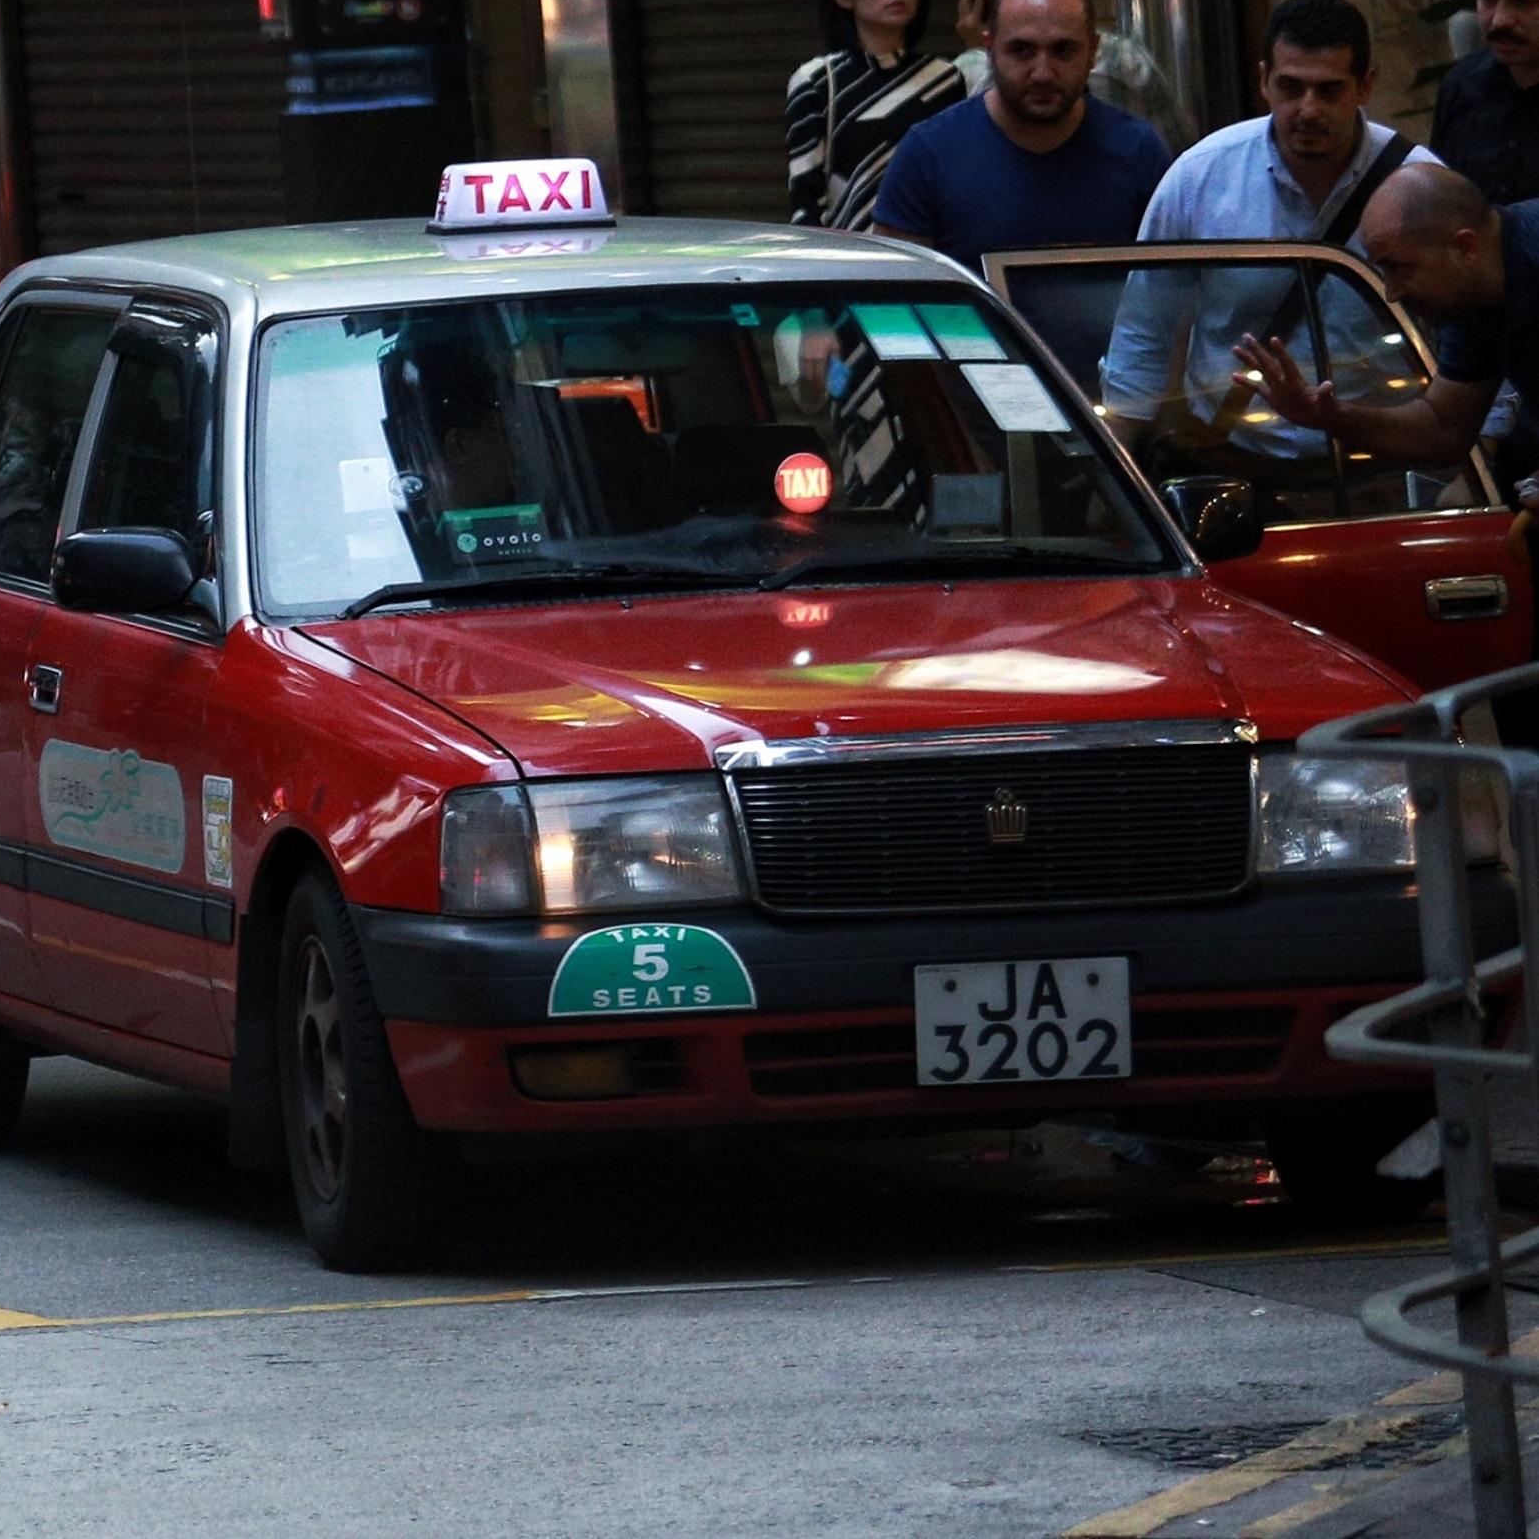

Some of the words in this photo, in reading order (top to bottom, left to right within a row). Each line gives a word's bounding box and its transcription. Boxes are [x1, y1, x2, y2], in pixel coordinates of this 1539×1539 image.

[463, 169, 593, 215] TAXI
[780, 468, 828, 499] TAXI
[606, 924, 686, 944] TAXI
[632, 943, 671, 982] 5
[592, 984, 713, 1010] SEATS
[978, 963, 1067, 1023] JA
[930, 1019, 1120, 1083] 3202
